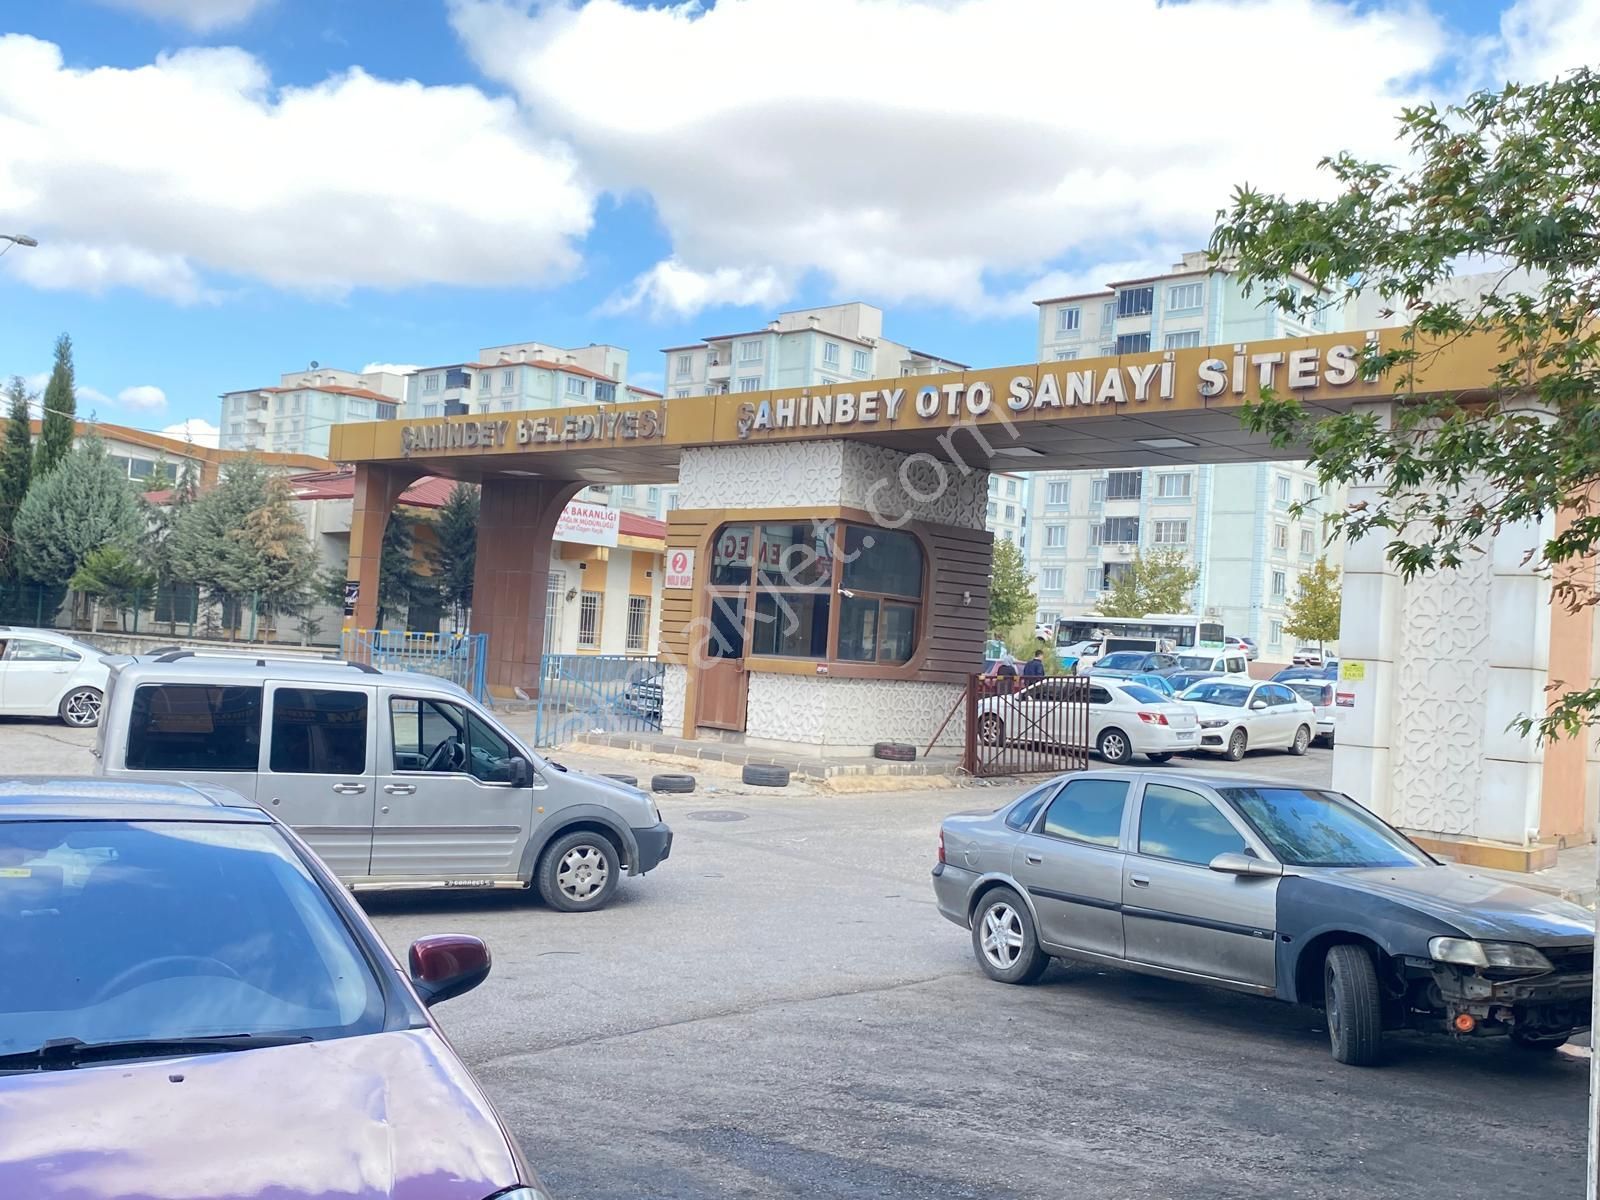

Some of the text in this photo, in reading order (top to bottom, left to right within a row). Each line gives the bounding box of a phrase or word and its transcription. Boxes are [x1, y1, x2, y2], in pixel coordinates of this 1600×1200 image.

[737, 329, 1381, 439] ŞAHİNBEY OTO SANAYİ SİTESİ
[401, 401, 668, 460] ŞAHİNBEY BELEDİYESİ
[571, 507, 617, 521] BAKANLIĞI
[675, 554, 684, 571] 2
